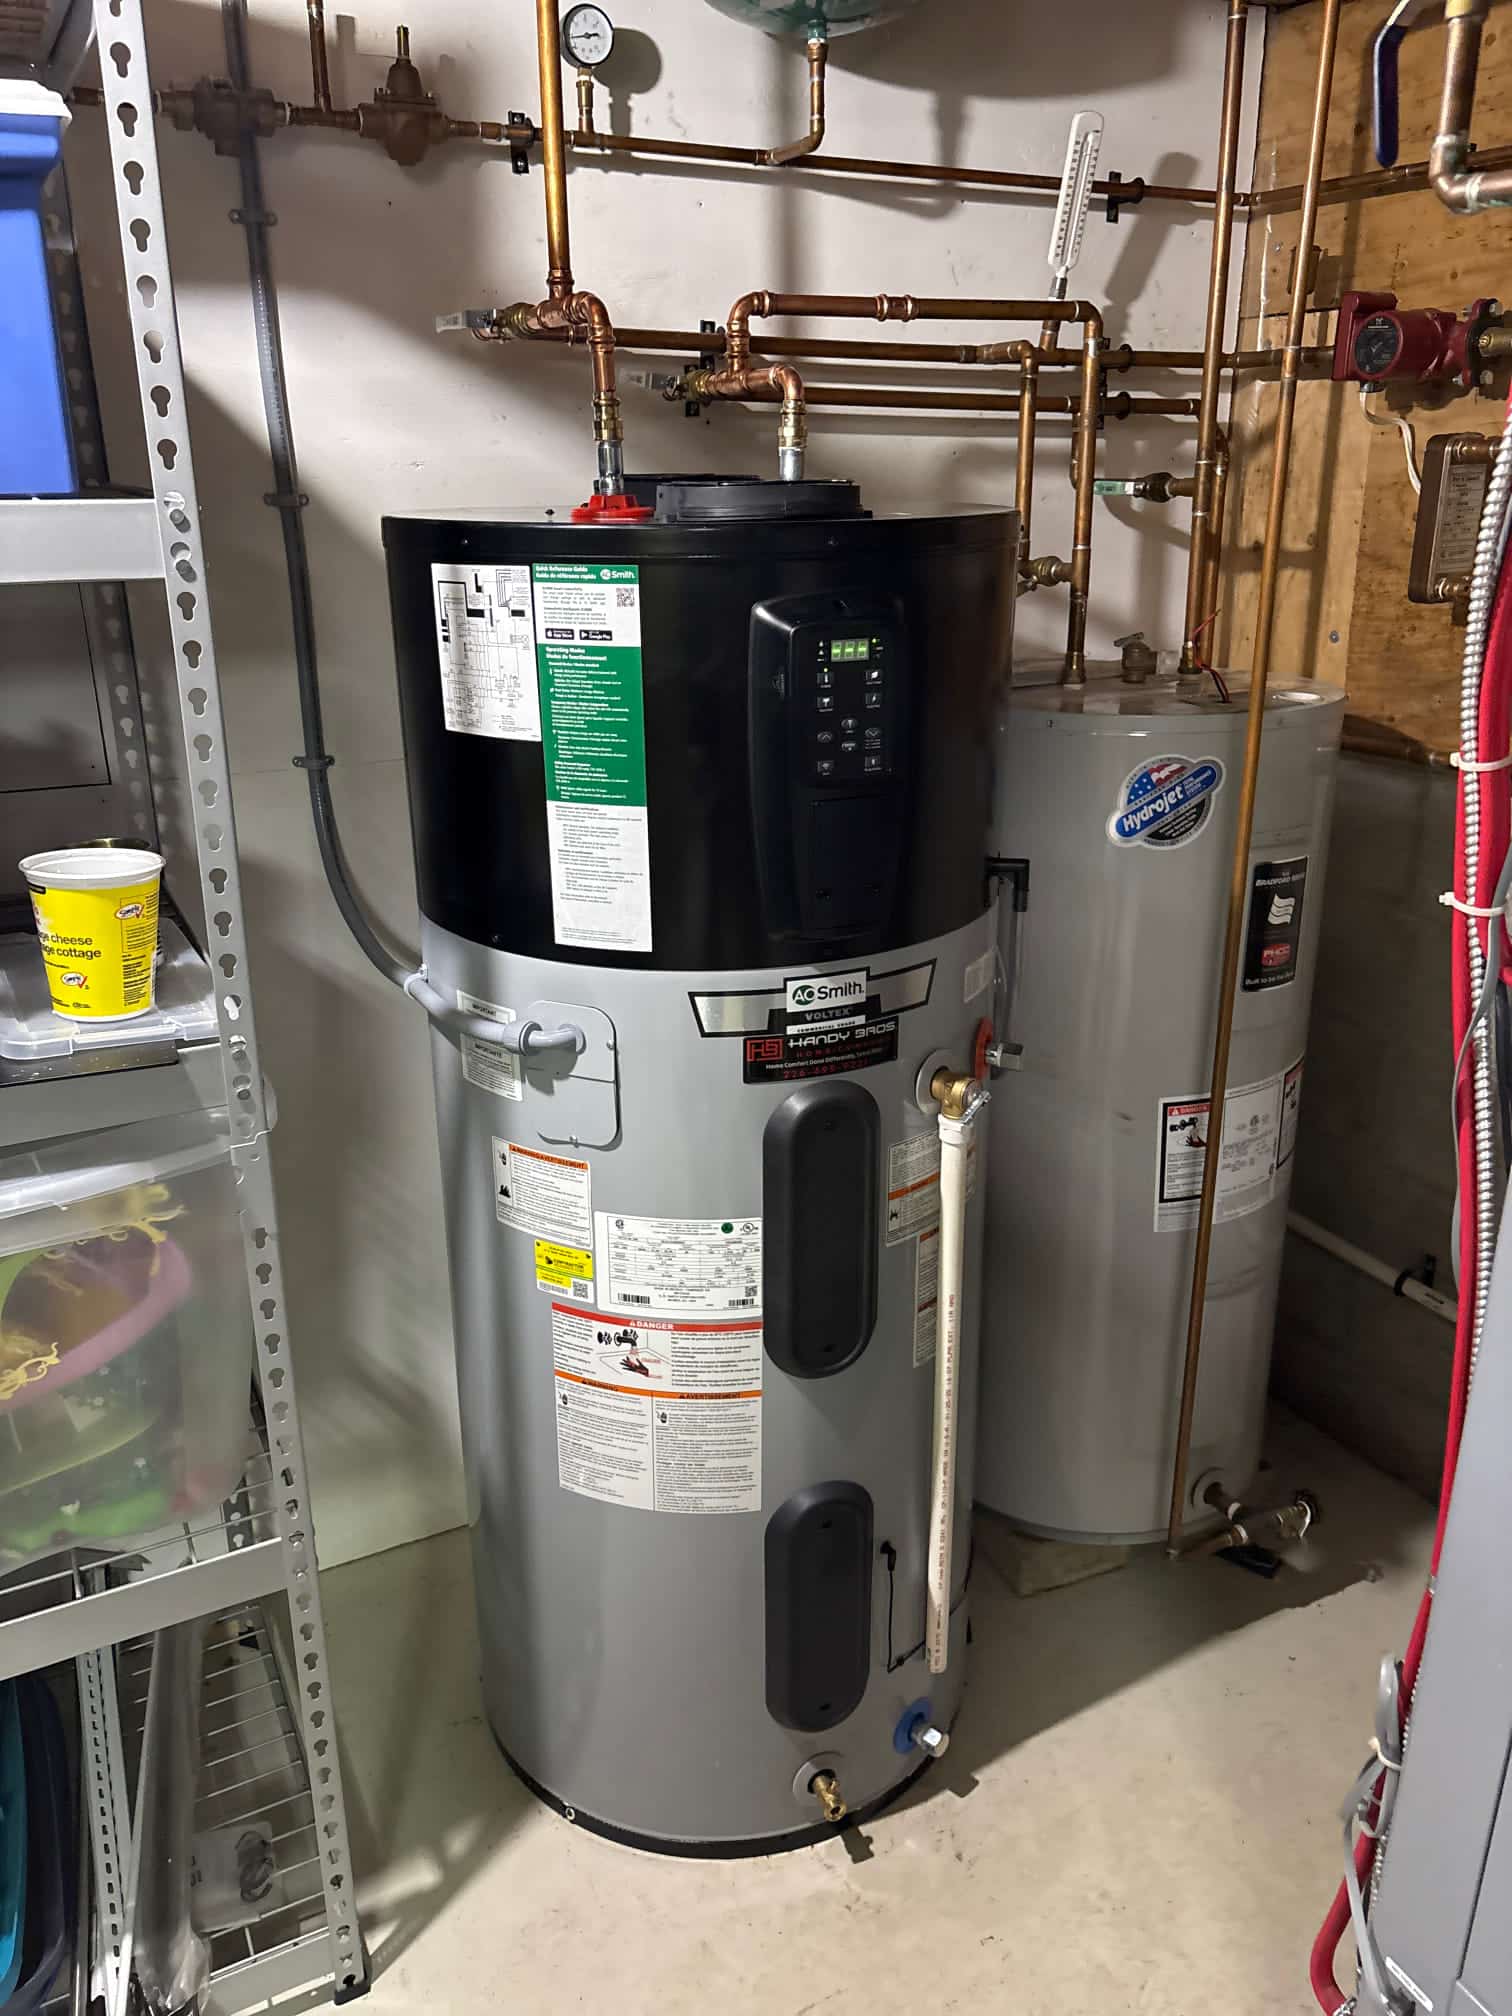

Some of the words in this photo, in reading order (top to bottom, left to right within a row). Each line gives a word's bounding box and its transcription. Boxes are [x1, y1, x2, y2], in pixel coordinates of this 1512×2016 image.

[1123, 786, 1183, 832] Hydrojet
[51, 932, 93, 946] cheese
[56, 947, 102, 960] cottage
[817, 981, 864, 1000] Smith
[804, 1008, 851, 1021] VOLTEX
[788, 1031, 851, 1048] HANDY
[855, 1021, 896, 1039] BROS
[636, 1320, 674, 1330] DANGER
